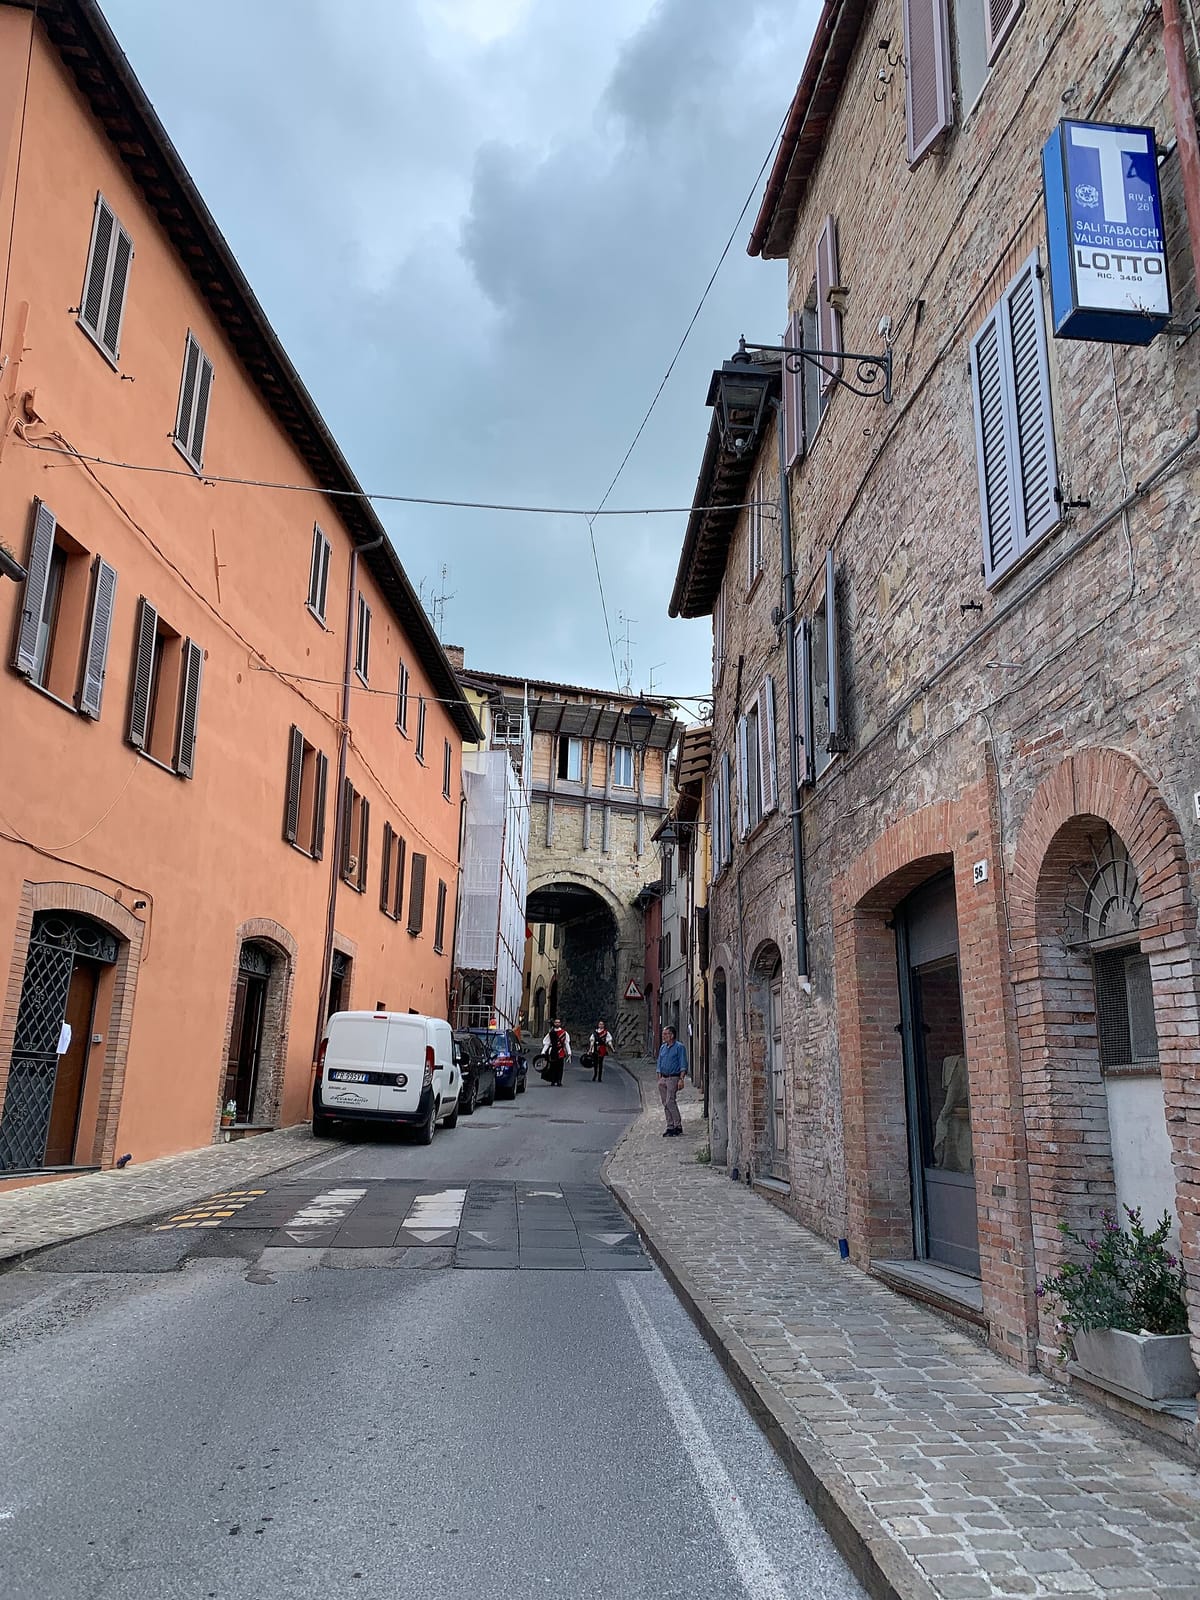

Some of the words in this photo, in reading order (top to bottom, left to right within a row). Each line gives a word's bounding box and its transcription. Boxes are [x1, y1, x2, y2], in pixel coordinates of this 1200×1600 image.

[1070, 126, 1149, 224] T
[1128, 193, 1147, 202] RIV.
[1137, 202, 1150, 212] 26
[1076, 220, 1100, 233] SALI
[1103, 224, 1159, 238] TABACCHI
[1074, 233, 1114, 247] VALORI
[1117, 237, 1163, 250] BOLLATI
[1077, 250, 1163, 275] LOTTO
[974, 865, 984, 880] 56
